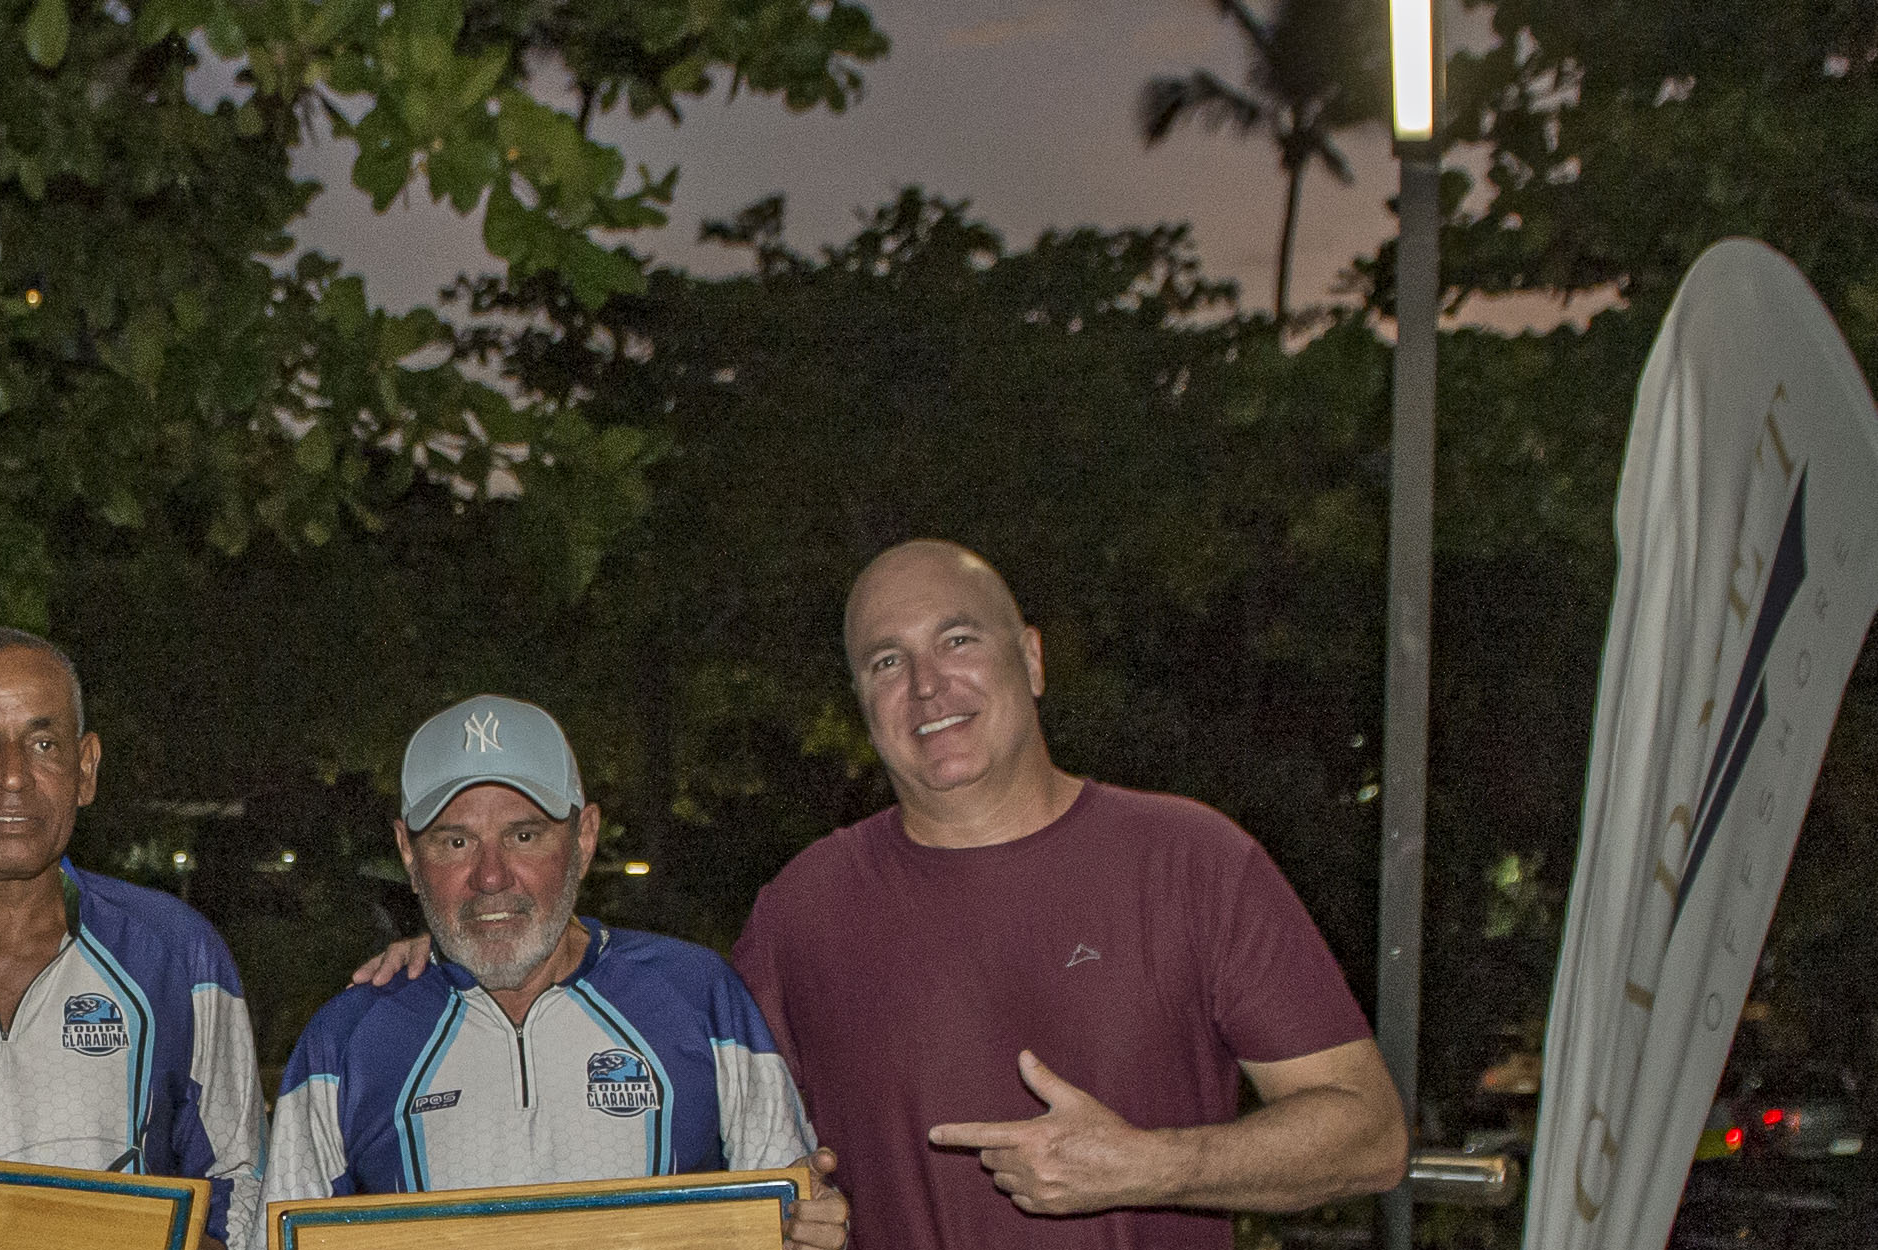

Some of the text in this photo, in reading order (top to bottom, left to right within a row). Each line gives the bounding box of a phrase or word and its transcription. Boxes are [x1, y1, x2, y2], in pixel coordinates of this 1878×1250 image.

[464, 711, 503, 752] NY
[63, 1025, 125, 1033] EQUIPE
[62, 1033, 130, 1047] CLARABINA
[587, 1083, 653, 1092] EQUIPE
[587, 1092, 657, 1107] CLARABINA
